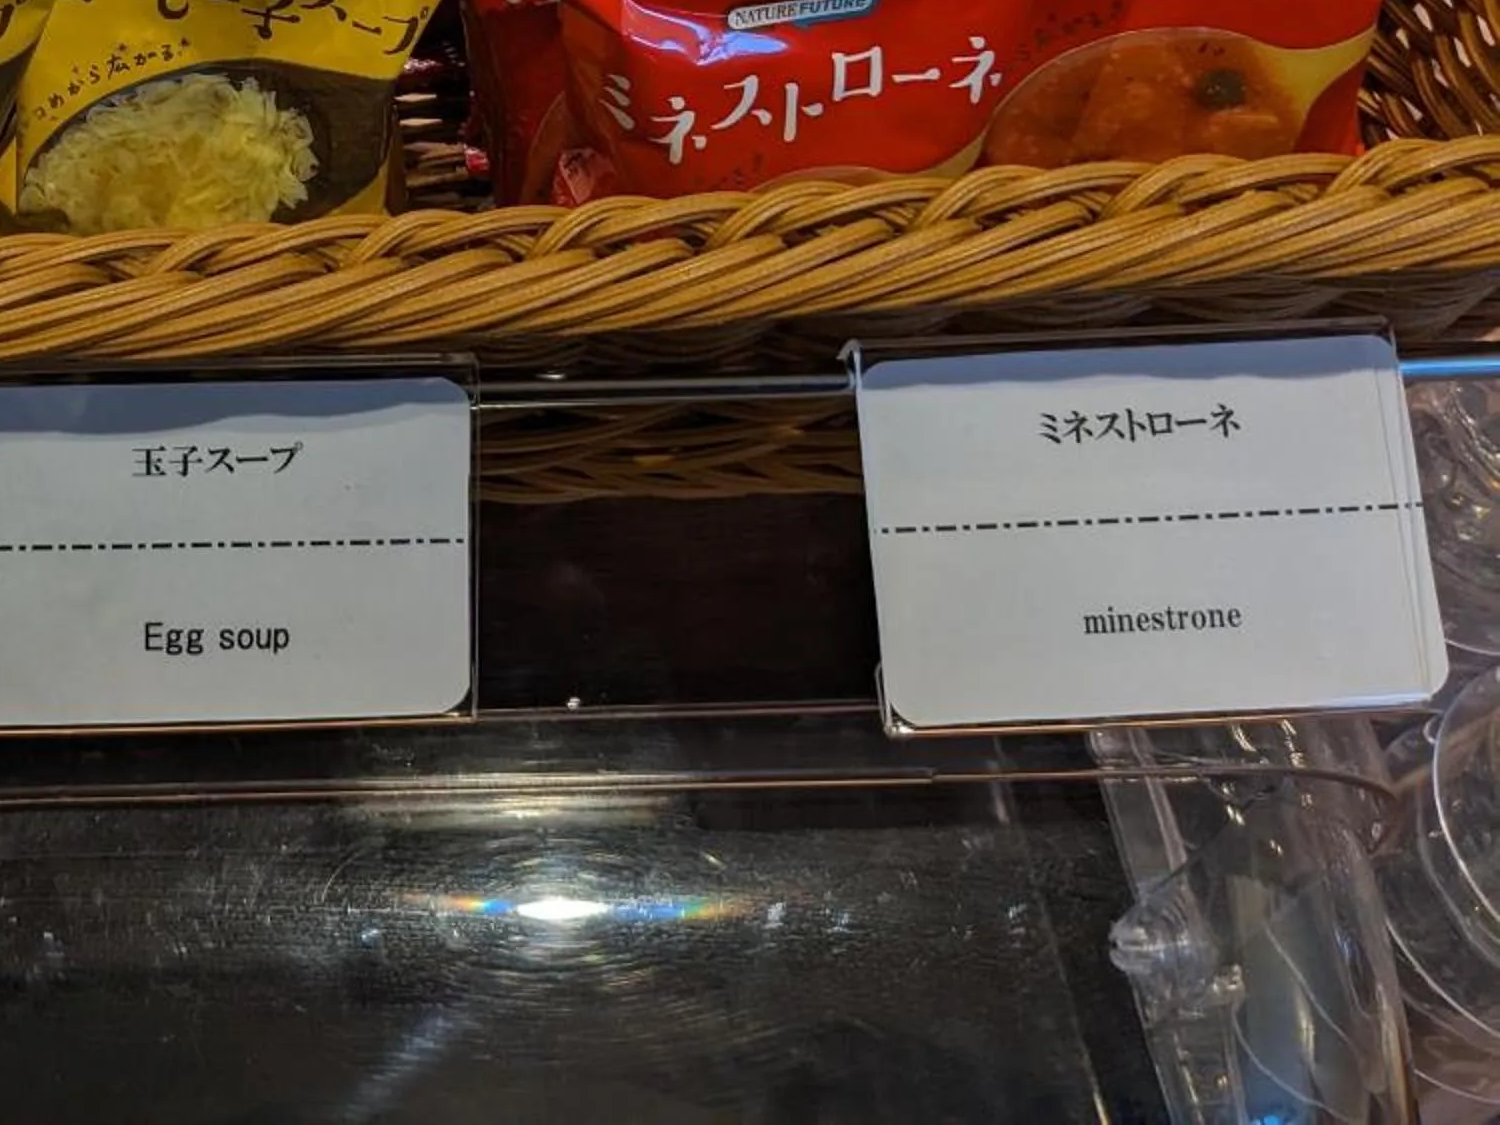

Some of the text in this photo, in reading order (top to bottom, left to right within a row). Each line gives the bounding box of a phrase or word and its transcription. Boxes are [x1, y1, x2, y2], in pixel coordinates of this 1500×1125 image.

[600, 36, 1002, 165] ミネストローネ
[1038, 403, 1242, 445] ミネストローネ
[131, 440, 304, 477] 玉子スープ
[143, 621, 290, 656] Egg soup
[1082, 606, 1243, 636] minestrone
